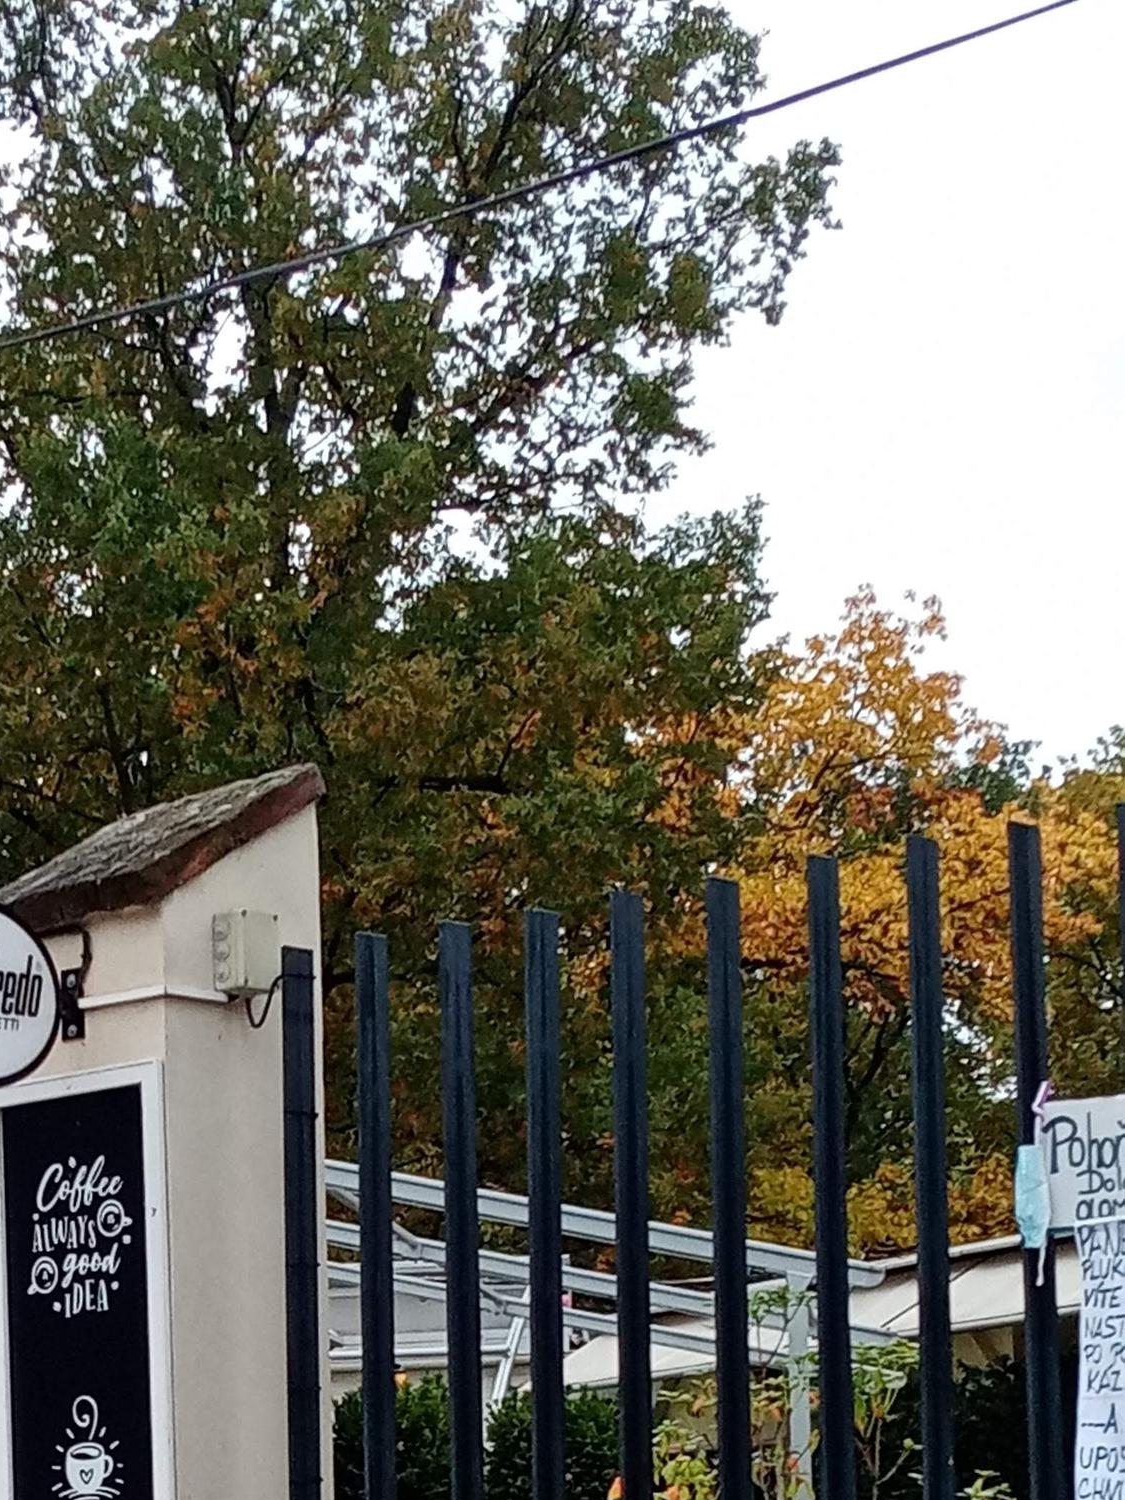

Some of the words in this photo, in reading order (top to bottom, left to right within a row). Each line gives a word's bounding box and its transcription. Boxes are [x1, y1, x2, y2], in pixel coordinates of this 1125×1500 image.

[36, 1155, 124, 1213] Coffee
[1076, 1166, 1125, 1195] Dol
[32, 1215, 96, 1253] ALWAYS
[61, 1242, 121, 1288] good
[64, 1279, 109, 1318] IDEA
